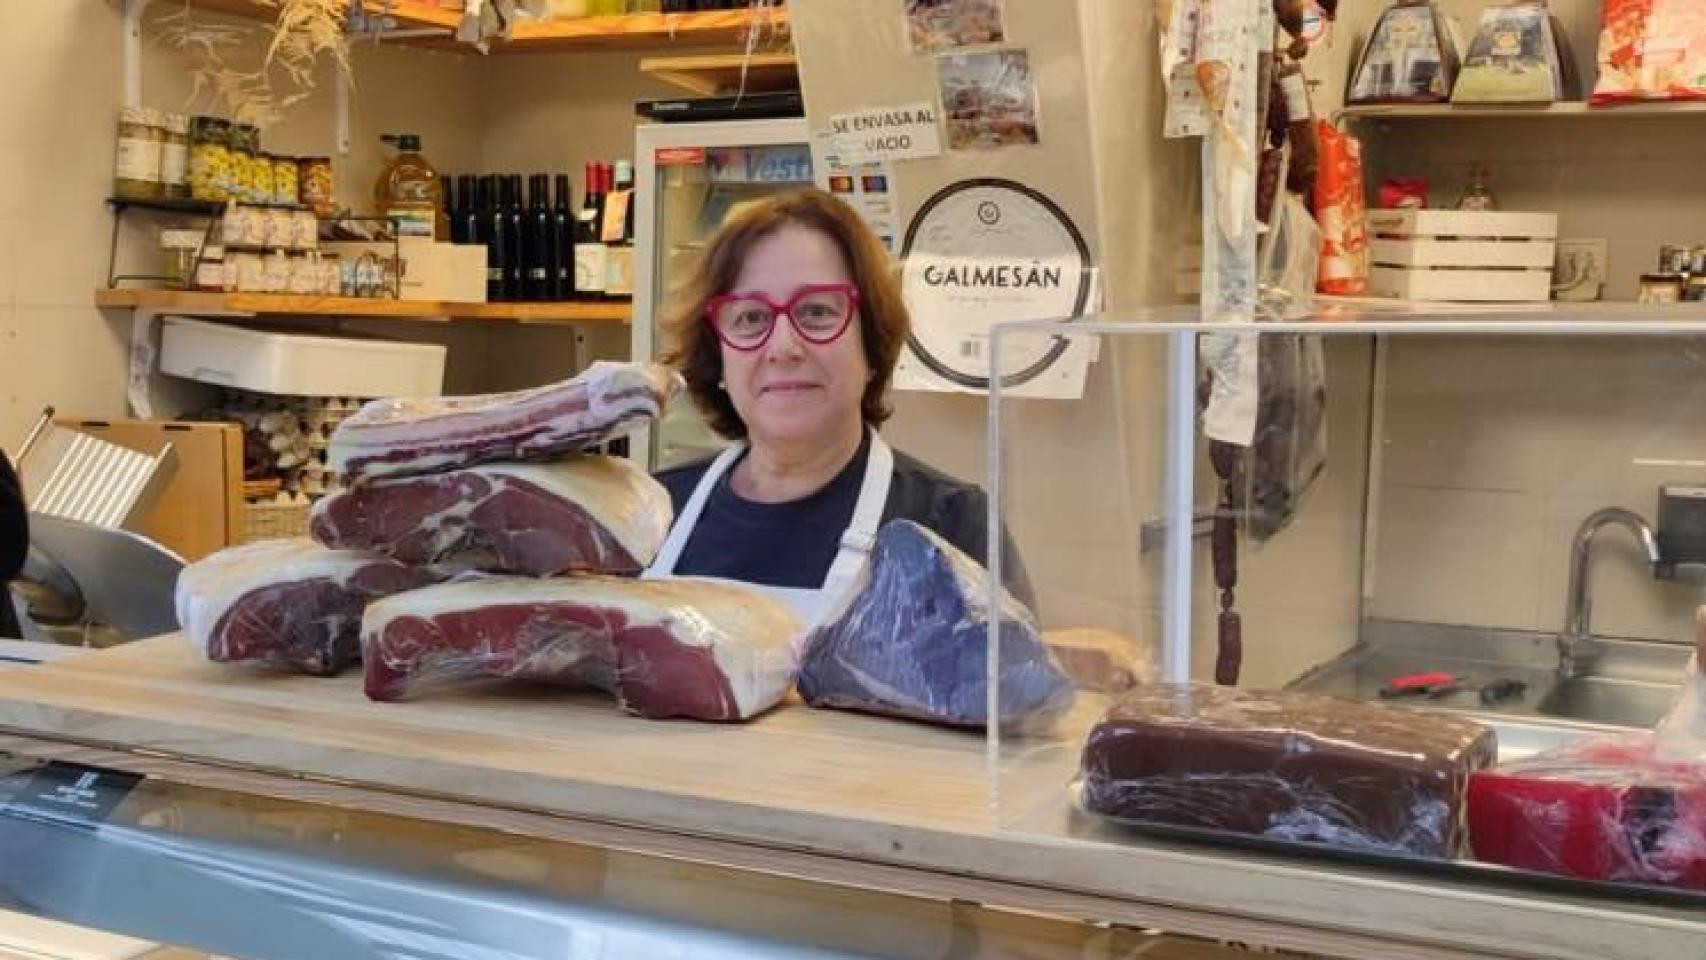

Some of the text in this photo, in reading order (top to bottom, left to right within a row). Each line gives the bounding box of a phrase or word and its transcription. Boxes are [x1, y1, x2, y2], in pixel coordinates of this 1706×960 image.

[833, 109, 933, 133] SE ENVASA AL
